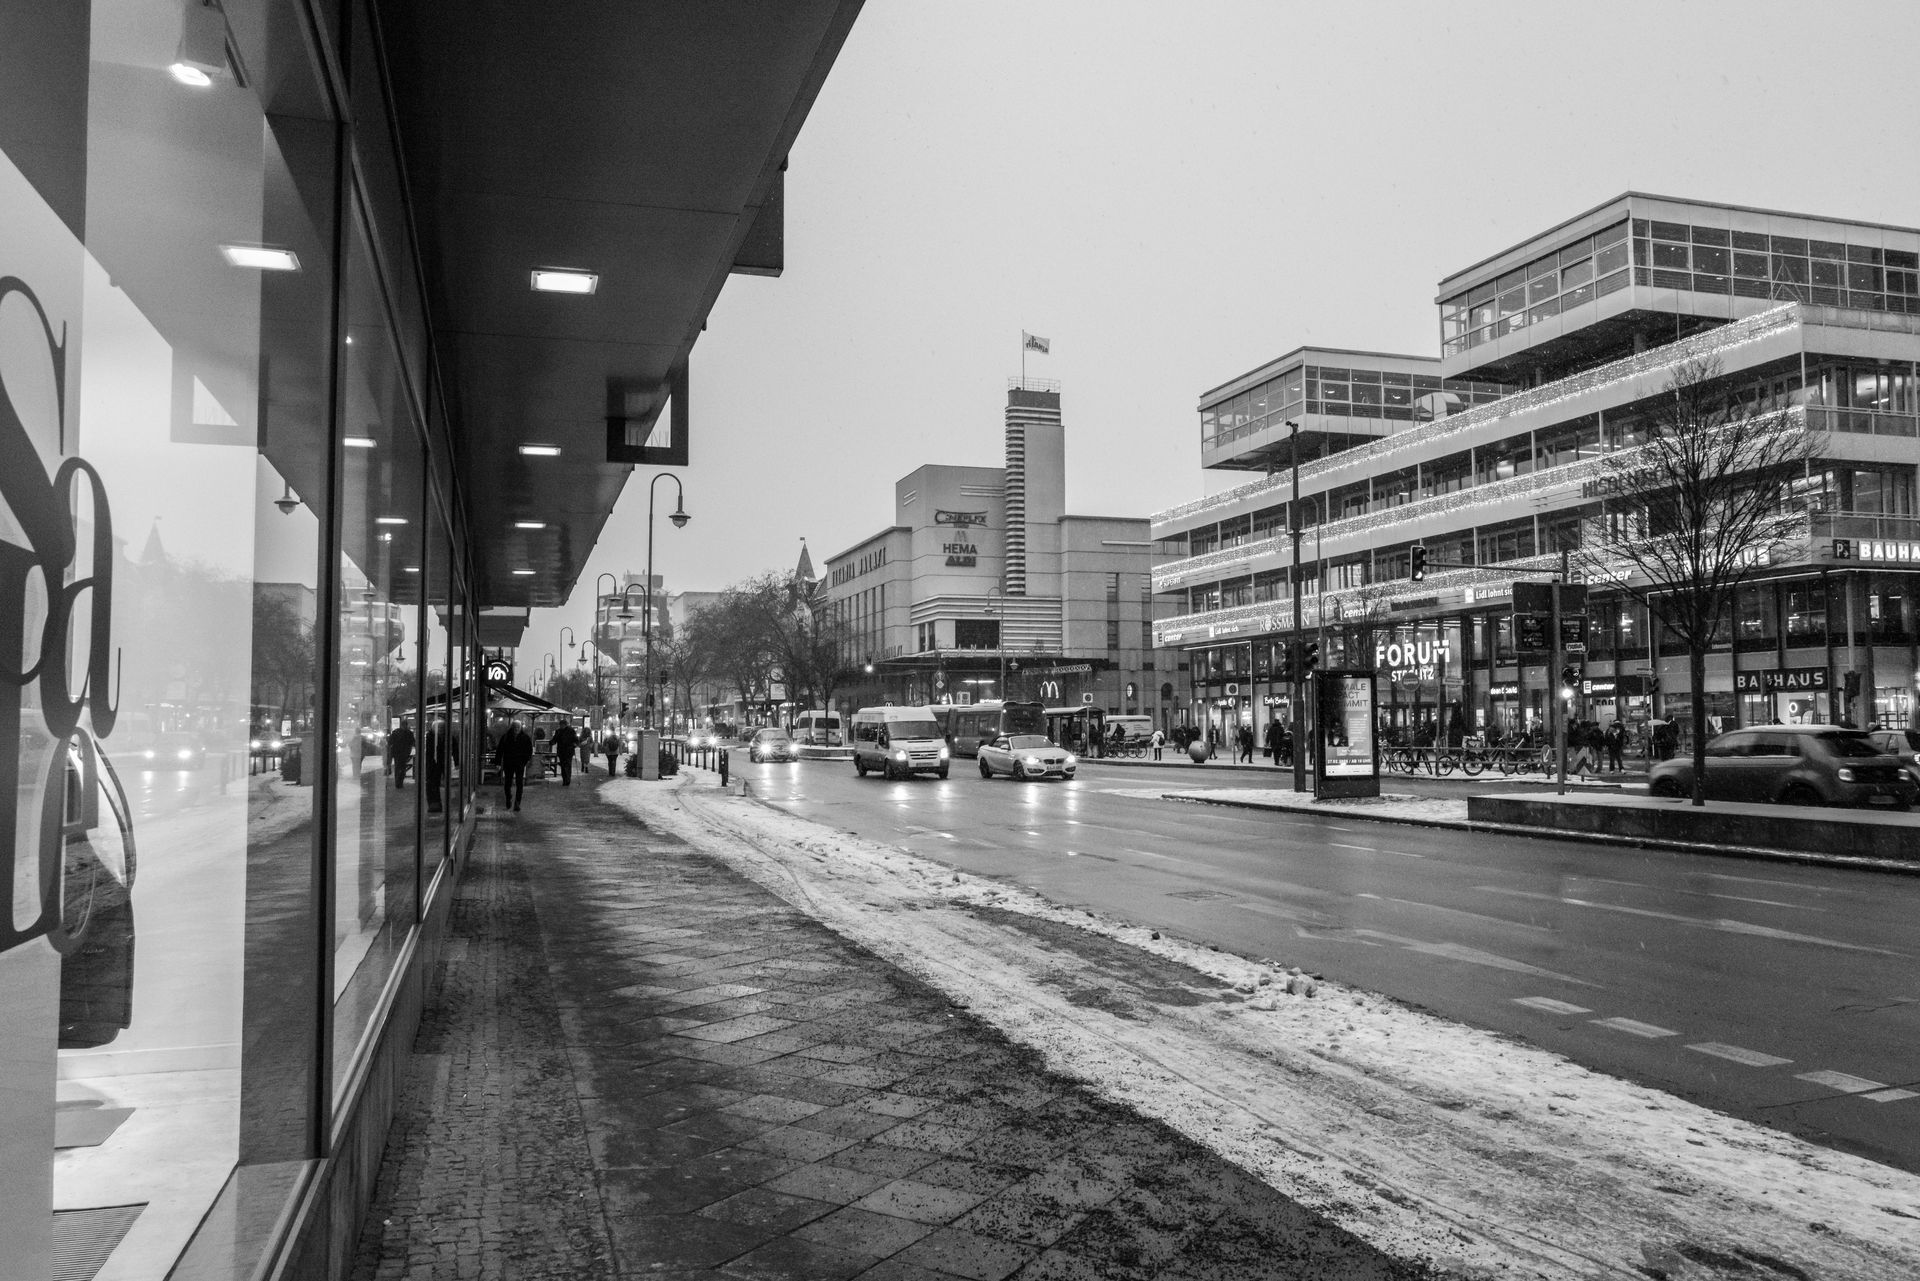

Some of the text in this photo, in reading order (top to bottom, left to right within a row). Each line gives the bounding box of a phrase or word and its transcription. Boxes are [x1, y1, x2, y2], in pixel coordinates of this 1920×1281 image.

[943, 543, 977, 554] HEMA
[1587, 570, 1632, 585] center
[1475, 589, 1488, 600] Lidl
[1504, 586, 1513, 596] sic
[1260, 613, 1310, 632] ROSSMAN
[1376, 639, 1450, 668] FORUM
[1737, 672, 1824, 688] BAHAUS
